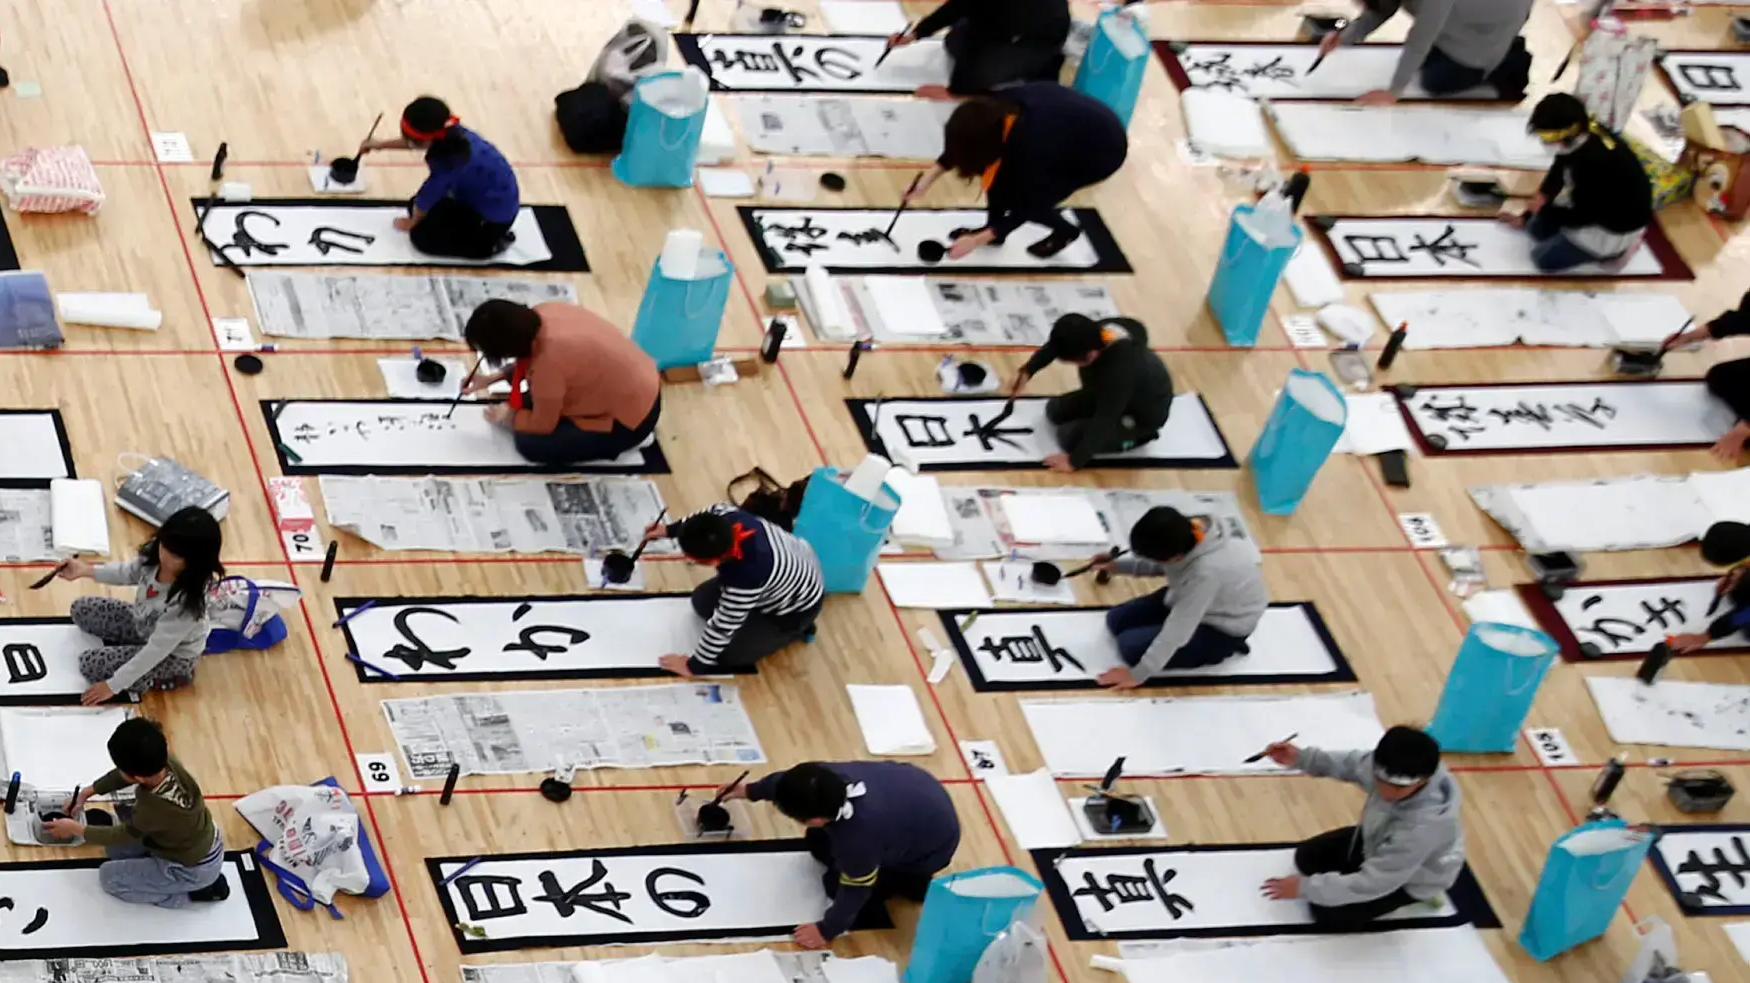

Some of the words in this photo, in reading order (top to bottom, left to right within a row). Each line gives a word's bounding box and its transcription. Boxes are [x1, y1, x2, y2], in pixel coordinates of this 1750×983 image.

[1344, 225, 1481, 269] 日本
[292, 533, 314, 553] 70
[384, 605, 590, 668] わか
[368, 761, 390, 783] 69
[455, 859, 710, 921] 日本の
[1072, 858, 1193, 921] 真
